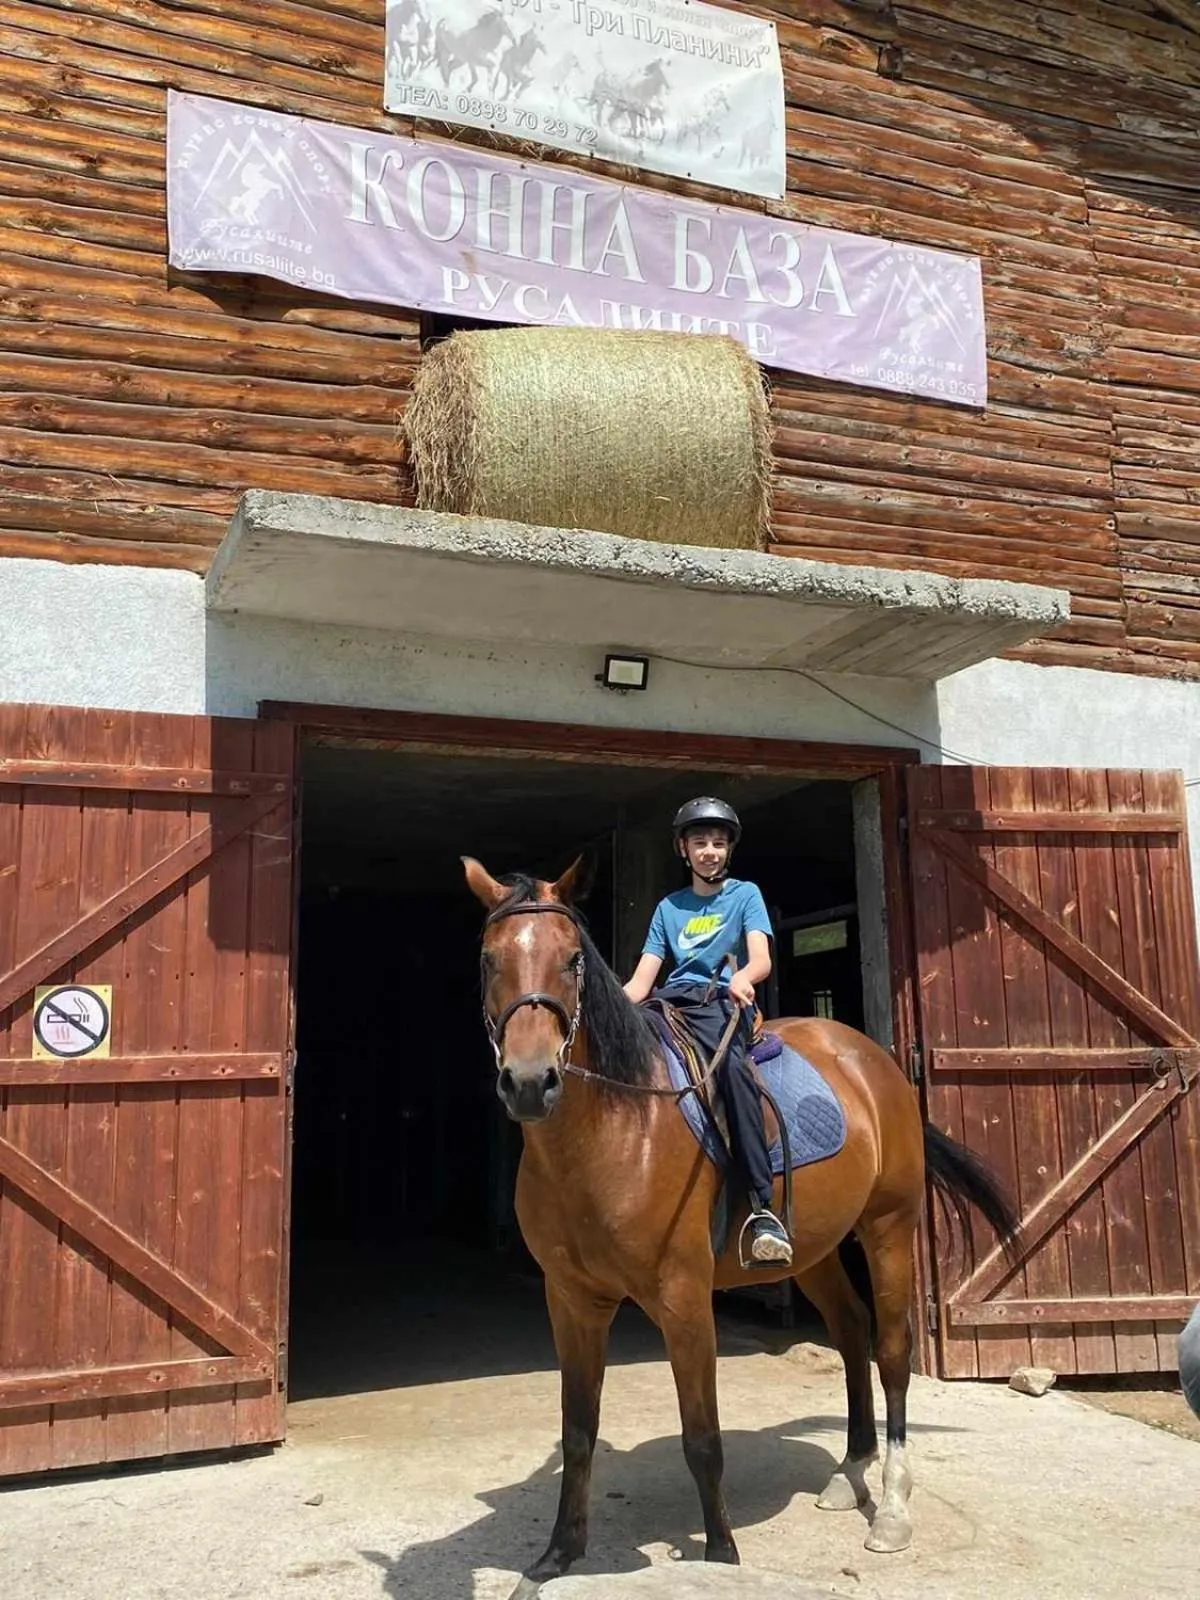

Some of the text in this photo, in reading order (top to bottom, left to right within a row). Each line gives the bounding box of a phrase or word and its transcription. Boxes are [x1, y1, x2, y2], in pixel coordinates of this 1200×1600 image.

[570, 0, 624, 36] Три
[396, 84, 598, 147] ТЕЛ: 0898 70 29 72
[344, 140, 857, 318] КОННА БАЗА
[684, 913, 723, 935] NIKE
